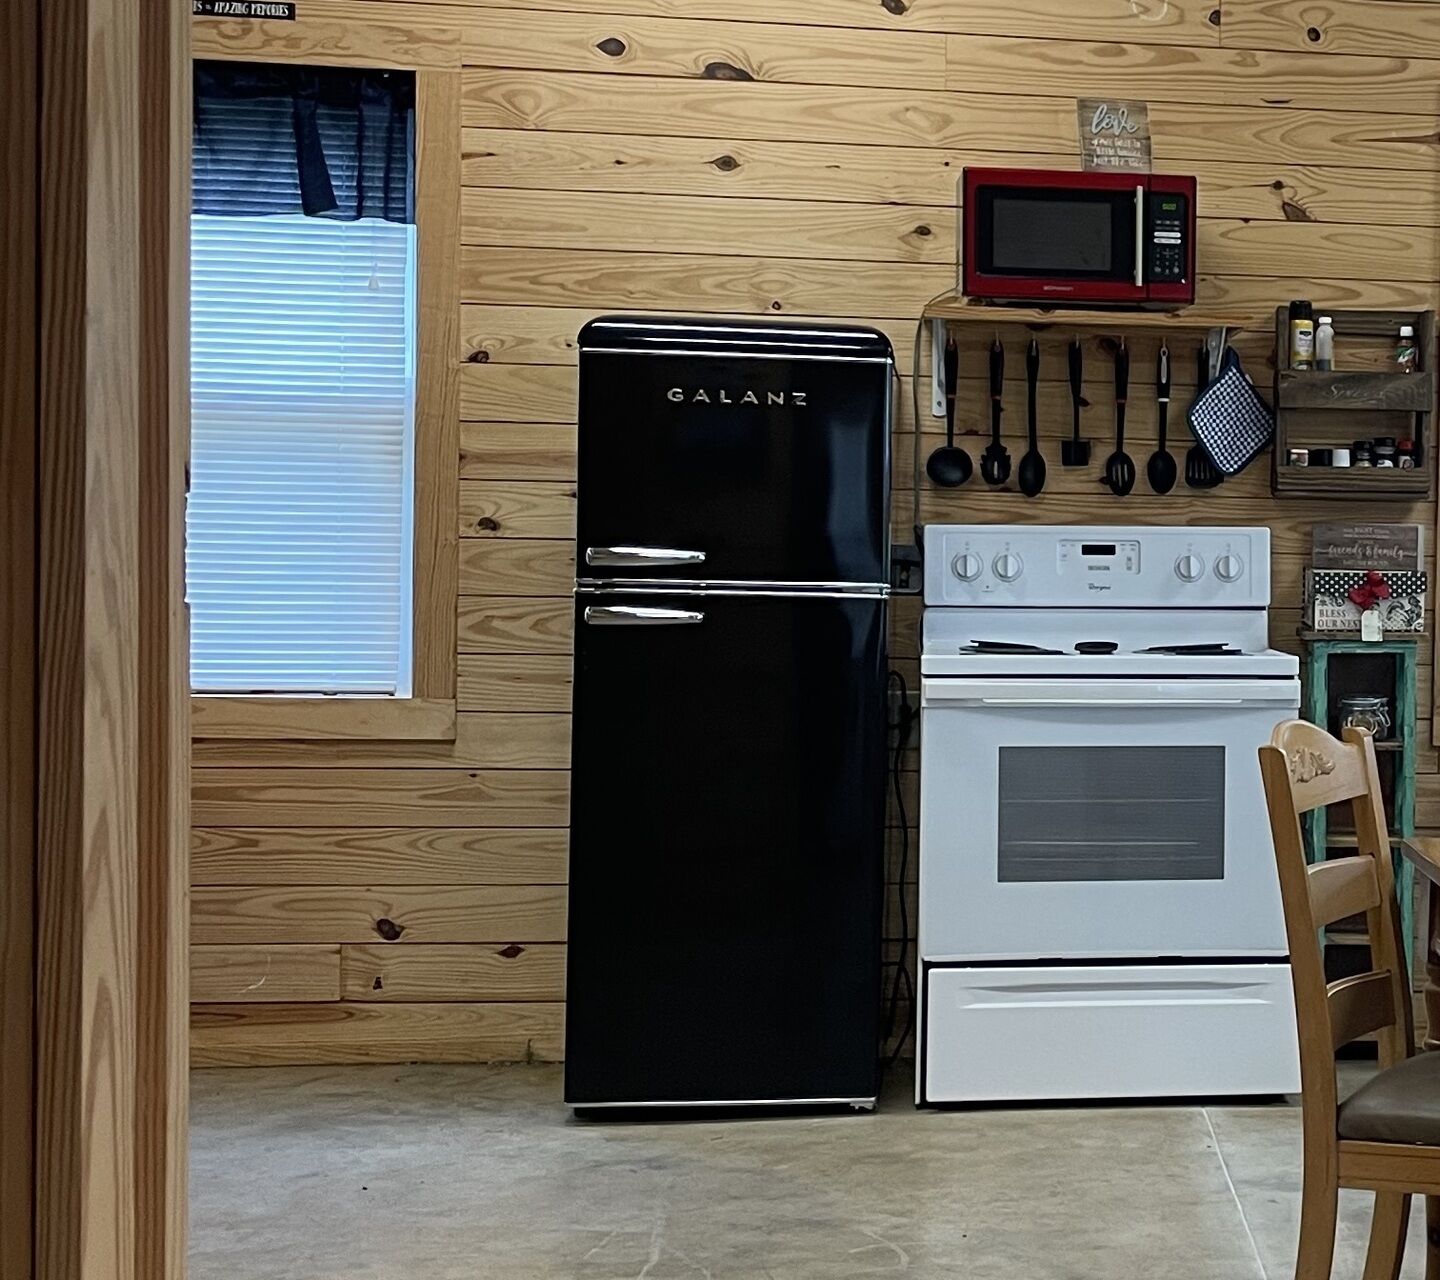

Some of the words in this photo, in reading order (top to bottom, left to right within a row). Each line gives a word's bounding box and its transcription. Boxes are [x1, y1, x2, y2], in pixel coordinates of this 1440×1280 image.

[214, 1, 249, 14] AMAZING
[1091, 104, 1140, 136] love
[667, 388, 807, 406] GALANZ
[1319, 608, 1347, 618] BLESS
[1317, 619, 1338, 628] OUR
